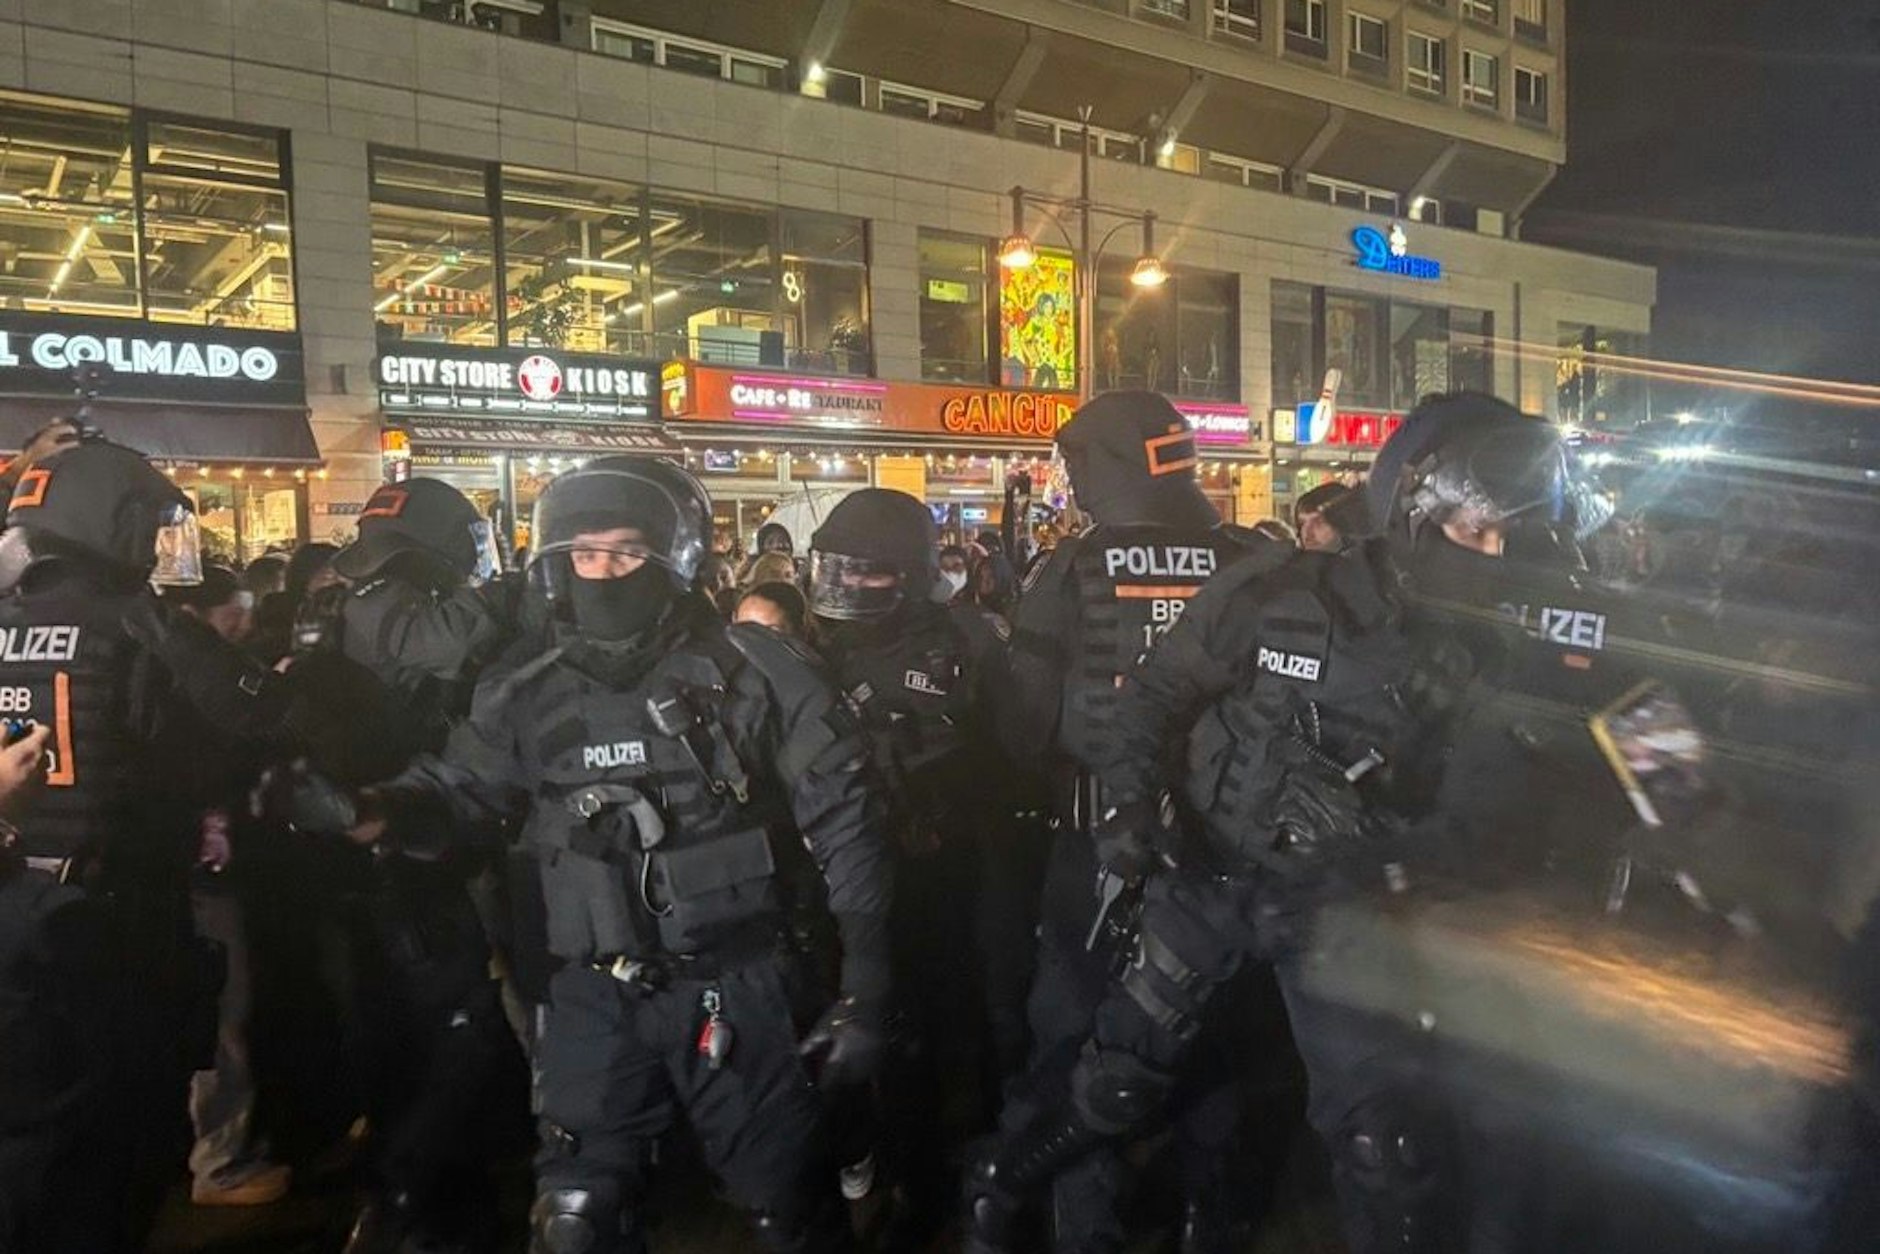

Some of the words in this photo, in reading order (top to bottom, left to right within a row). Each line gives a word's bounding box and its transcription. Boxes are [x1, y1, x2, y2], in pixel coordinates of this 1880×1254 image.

[32, 332, 278, 381] COLMADO
[381, 355, 434, 384] CITY
[440, 358, 511, 389] STORE
[567, 367, 647, 396] KIOSK
[413, 426, 467, 440] CITY
[469, 430, 543, 444] STORE
[588, 434, 666, 448] KIOSK
[1105, 546, 1217, 577] POLIZEI
[1257, 646, 1321, 682] POLIZEI
[583, 740, 647, 769] POLIZEI
